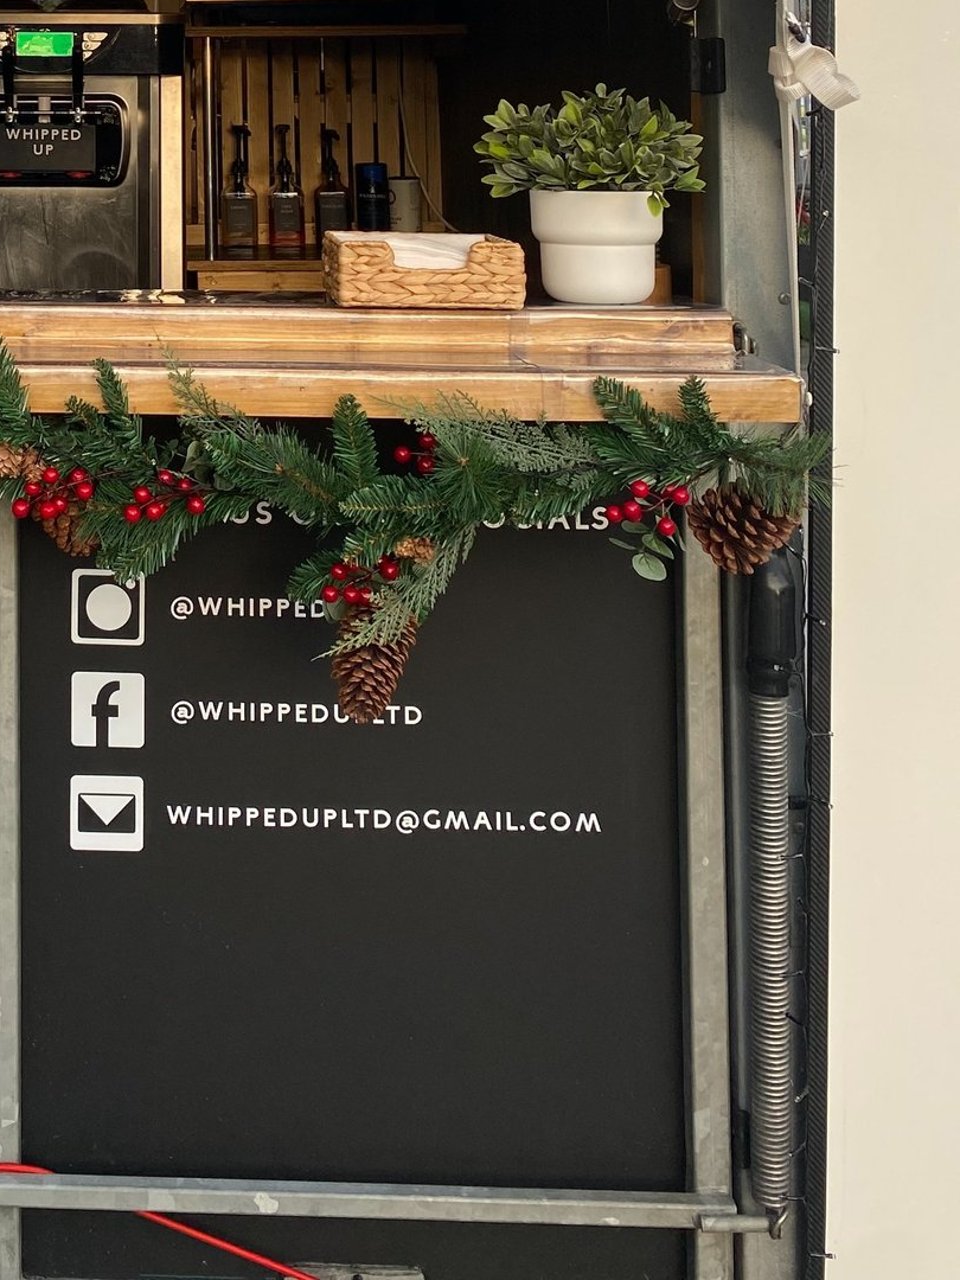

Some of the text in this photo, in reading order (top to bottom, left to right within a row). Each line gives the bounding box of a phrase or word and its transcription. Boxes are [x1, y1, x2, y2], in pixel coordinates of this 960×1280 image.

[6, 128, 82, 141] WHIPPED
[33, 144, 54, 156] UP
[171, 701, 422, 725] @WHIPPEDUTD
[166, 805, 602, 834] WHIPPEDUPLTD@GMAIL.COM
